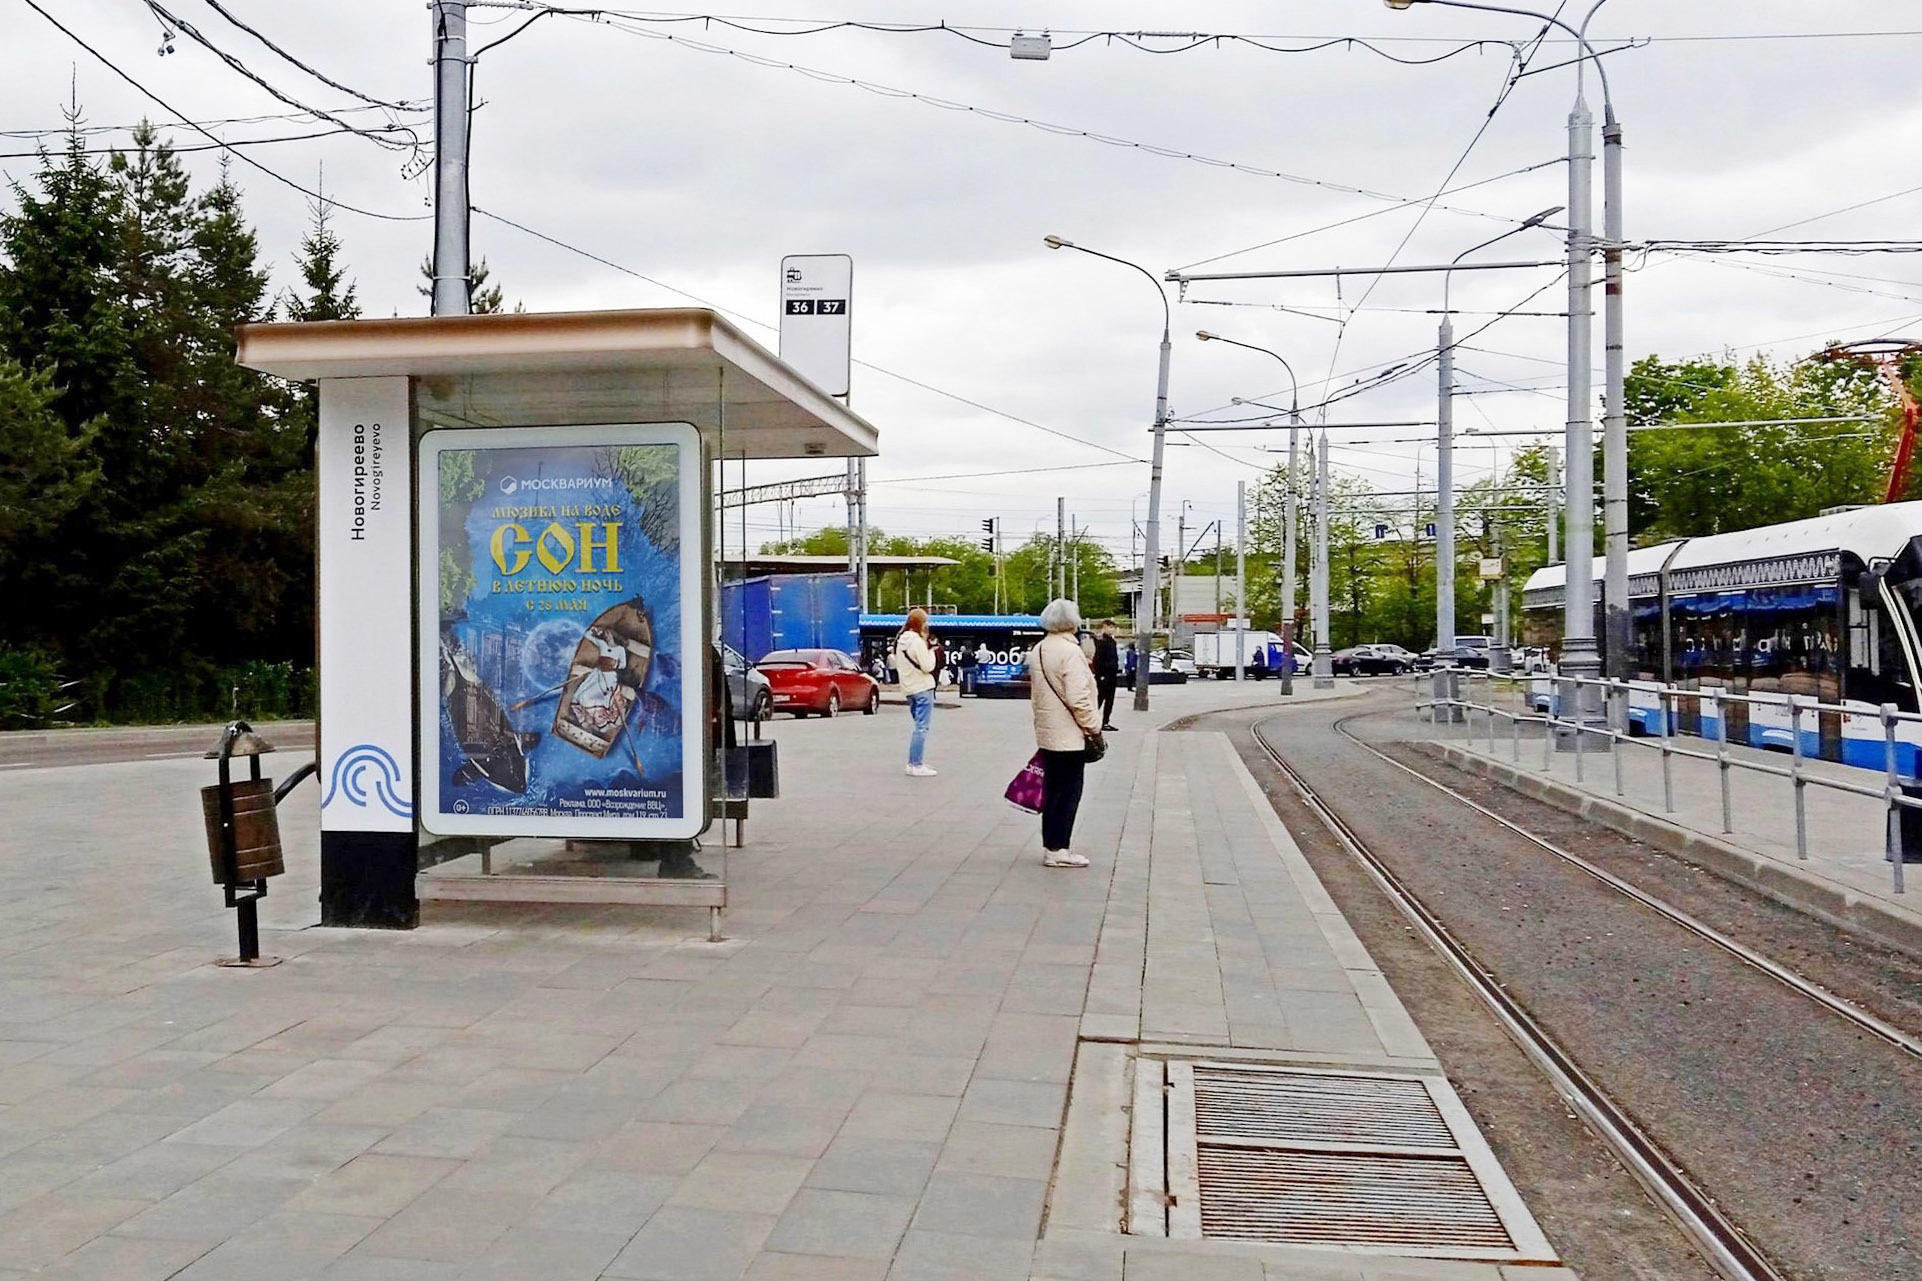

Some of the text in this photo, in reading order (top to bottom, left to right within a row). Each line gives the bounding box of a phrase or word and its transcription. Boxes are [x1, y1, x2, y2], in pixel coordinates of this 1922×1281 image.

[792, 302, 840, 313] 36 37
[371, 423, 383, 510] Novogireyevo
[351, 424, 368, 540] Новогиреево
[521, 478, 613, 490] МОСКВАРИУМ
[492, 504, 622, 518] МЮЗИКЛ НА ВОДЕ
[490, 522, 624, 576] СОН
[492, 579, 623, 593] В ЛЕТНЮЮ НОЧЬ
[555, 600, 587, 610] МАЯ
[584, 788, 667, 798] www.moskvarium.ru
[456, 804, 466, 812] 0+
[587, 799, 601, 808] ООО
